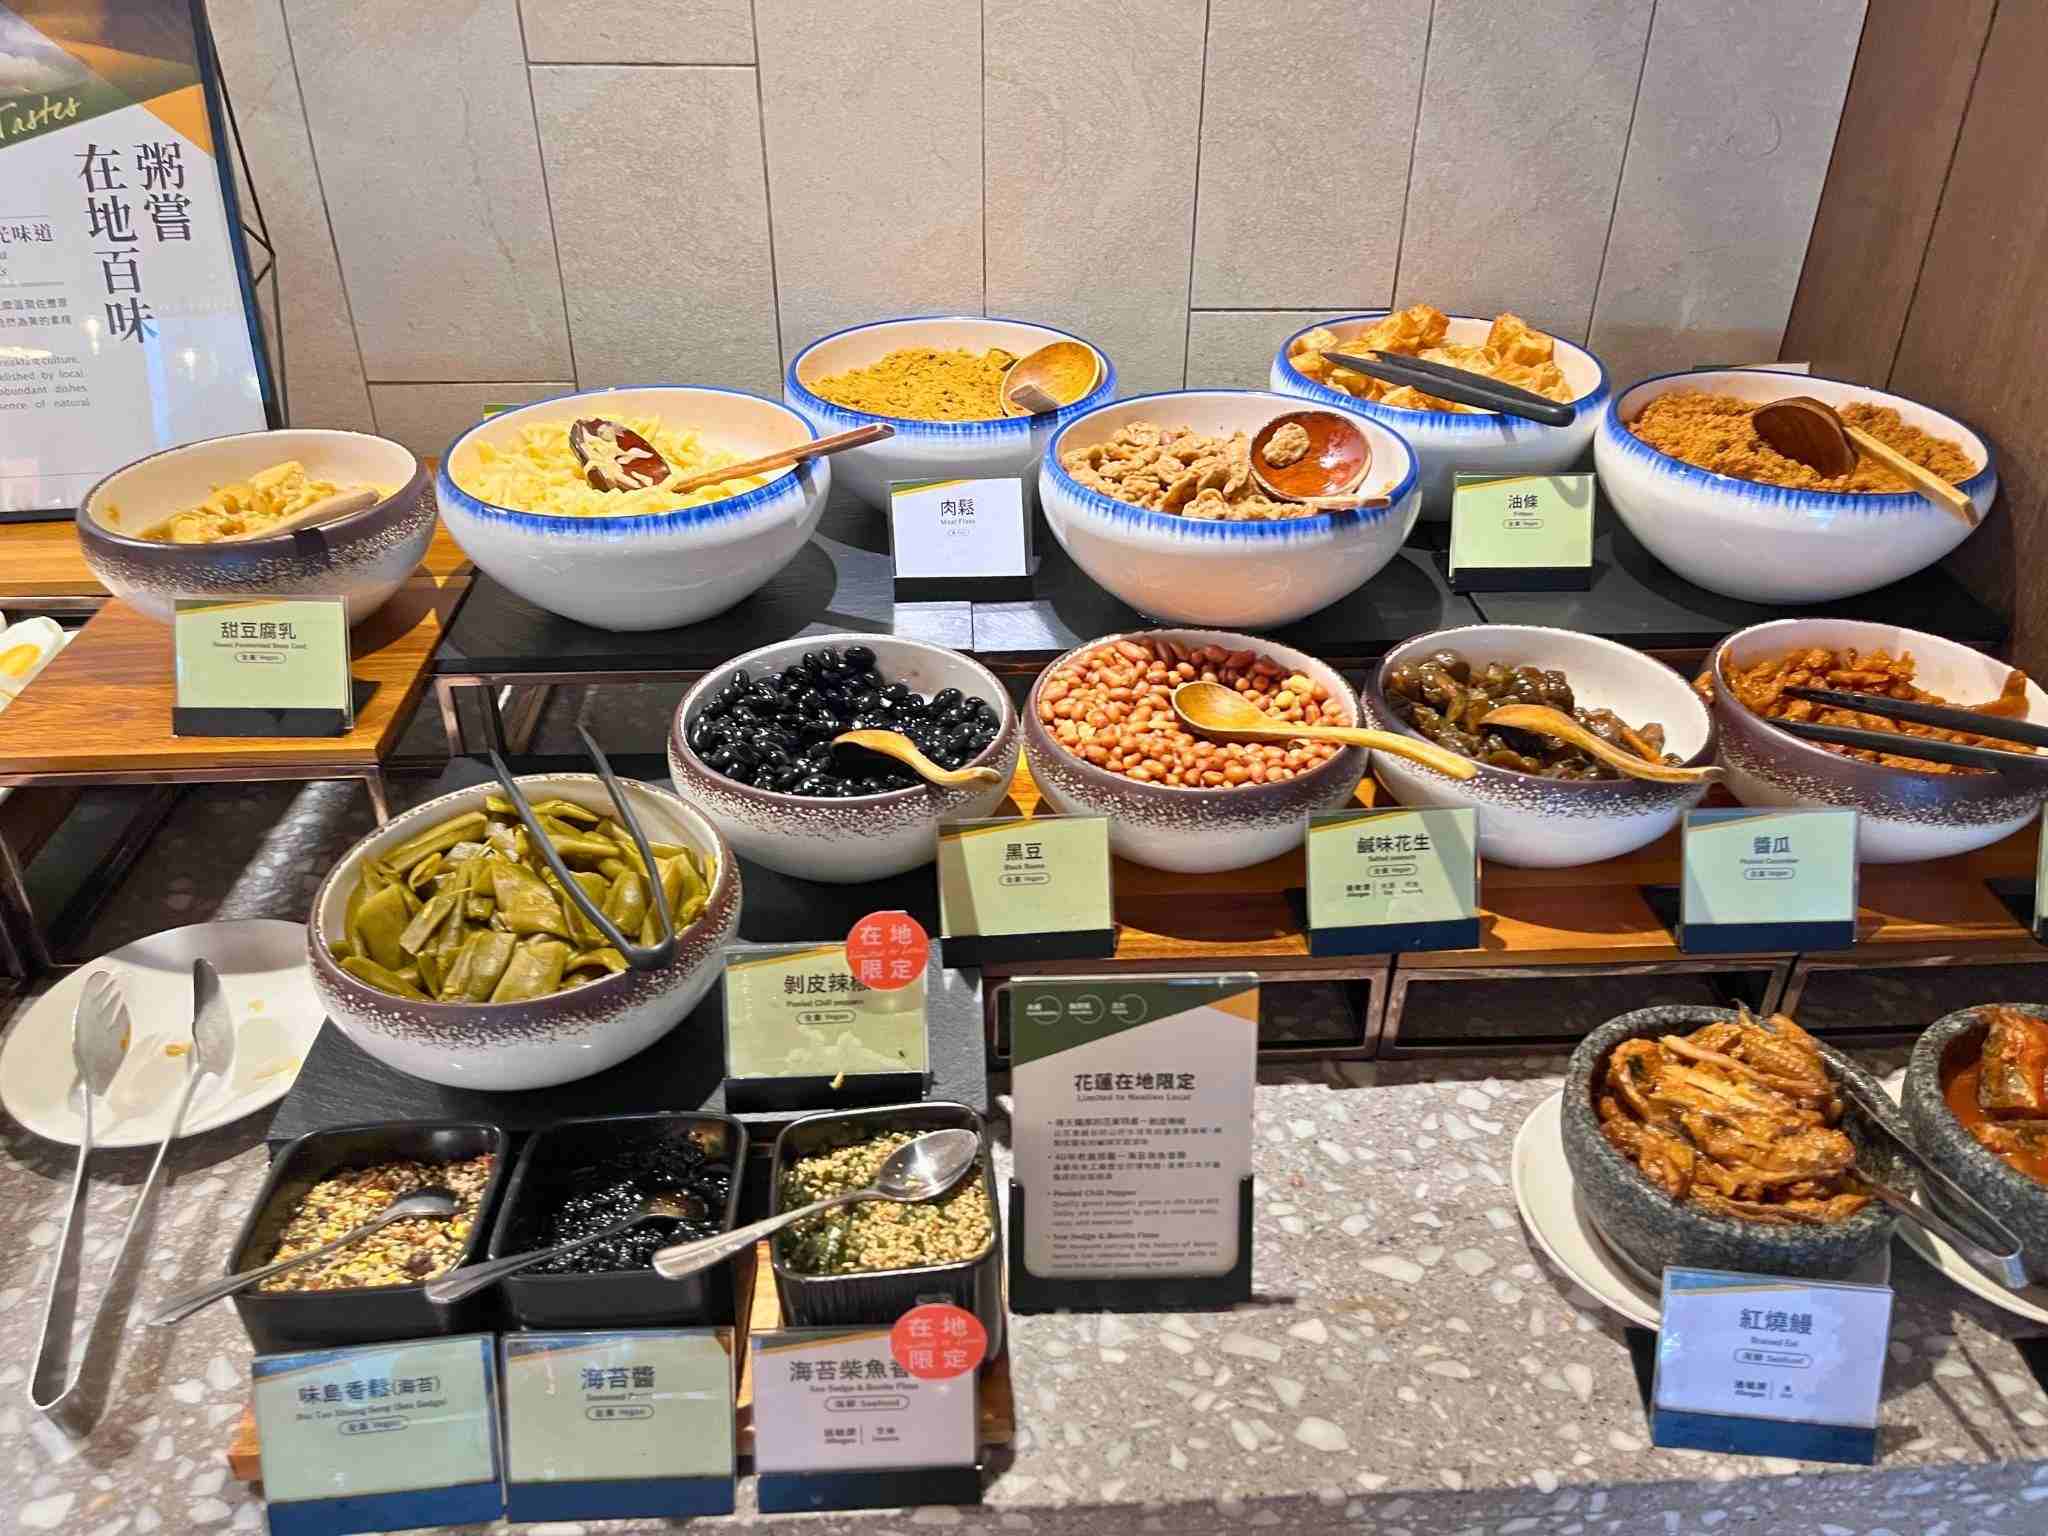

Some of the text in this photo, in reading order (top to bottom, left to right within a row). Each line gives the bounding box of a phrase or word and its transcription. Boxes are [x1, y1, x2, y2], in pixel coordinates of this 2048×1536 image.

[133, 141, 193, 243] 粥嘗
[74, 143, 161, 344] 在地百味
[940, 498, 975, 517] 肉鬆
[1508, 494, 1538, 509] 油條
[220, 621, 297, 640] 甜豆腐乳
[1006, 842, 1043, 861] 黑豆
[1357, 833, 1431, 854] 鹹味花生
[859, 923, 913, 946] 在地
[860, 959, 913, 980] 限定
[1074, 1072, 1196, 1092] 花蓮在地限定
[908, 1316, 968, 1337] 在地
[1739, 1308, 1813, 1336] 紅燒鰻
[908, 1350, 969, 1369] 限定
[581, 1365, 656, 1390] 海苔醬
